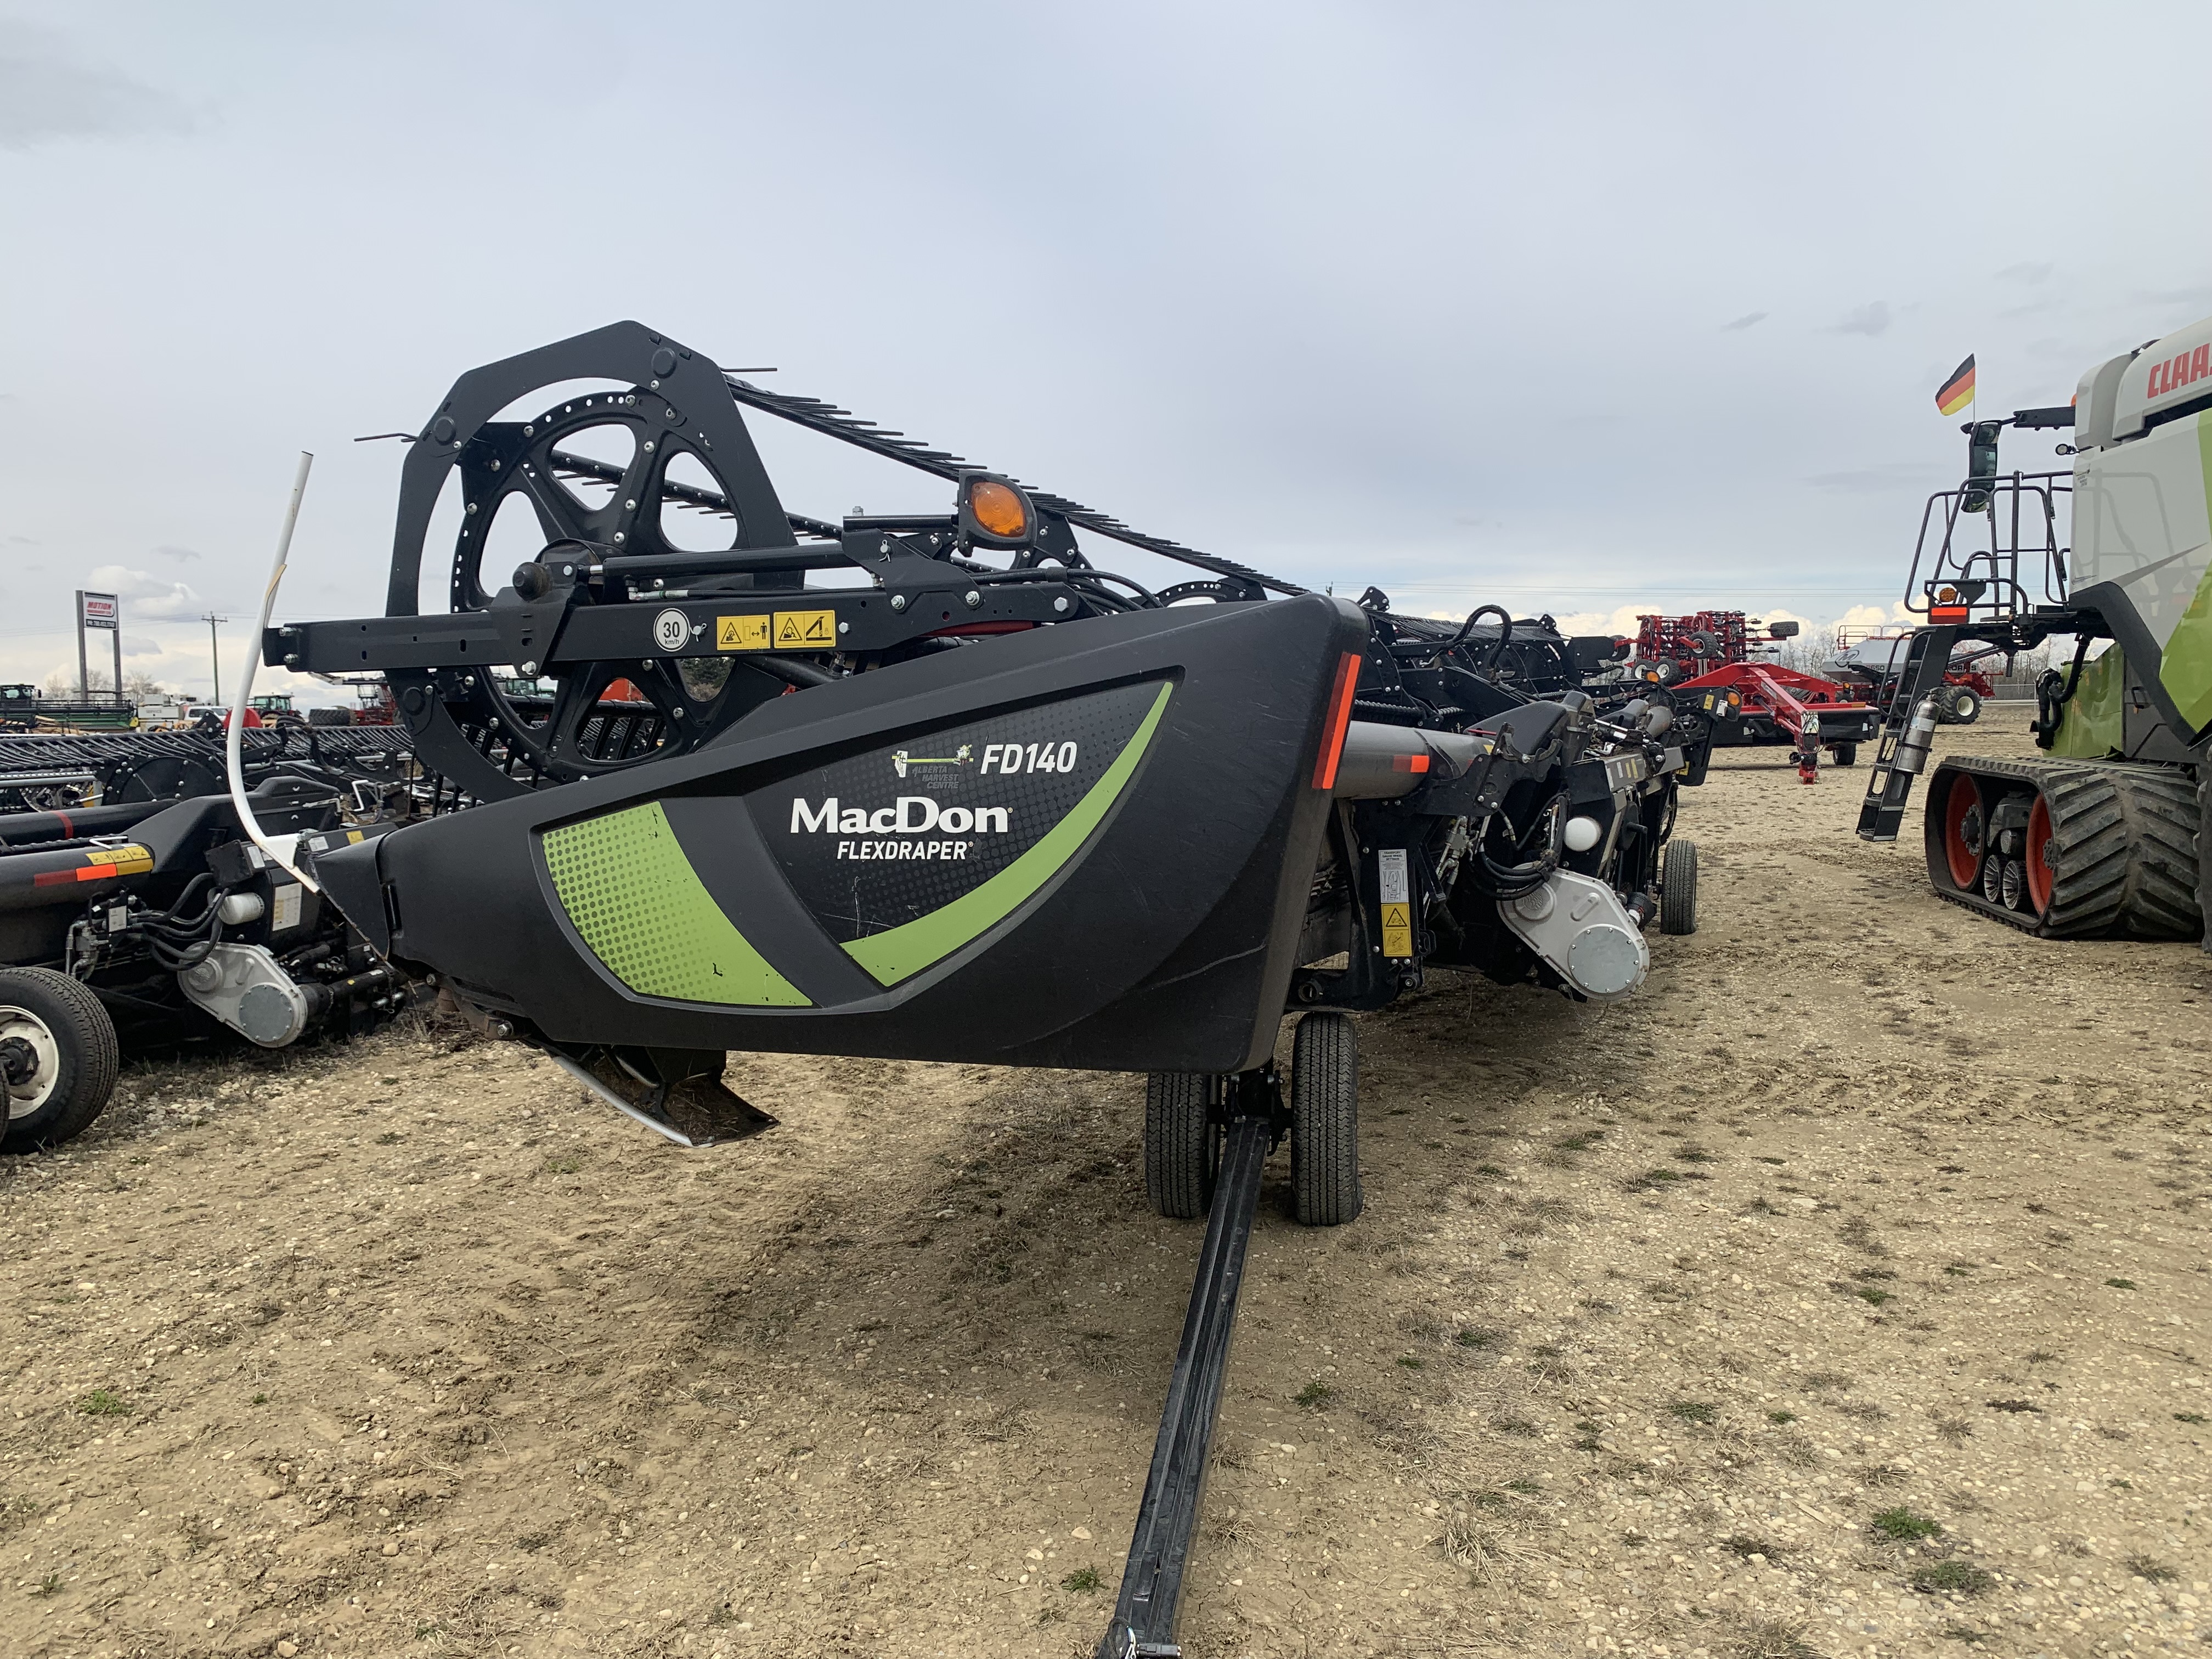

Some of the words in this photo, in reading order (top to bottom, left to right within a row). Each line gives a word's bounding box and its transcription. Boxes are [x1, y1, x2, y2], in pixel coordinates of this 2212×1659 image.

[2147, 342, 2212, 399] CLAA
[87, 601, 112, 610] MOTION
[663, 621, 680, 638] 30
[980, 741, 1077, 775] FD140
[912, 766, 948, 777] ALBERTA
[790, 797, 1008, 833] MacDon
[837, 841, 967, 860] FLEXDRAPER
